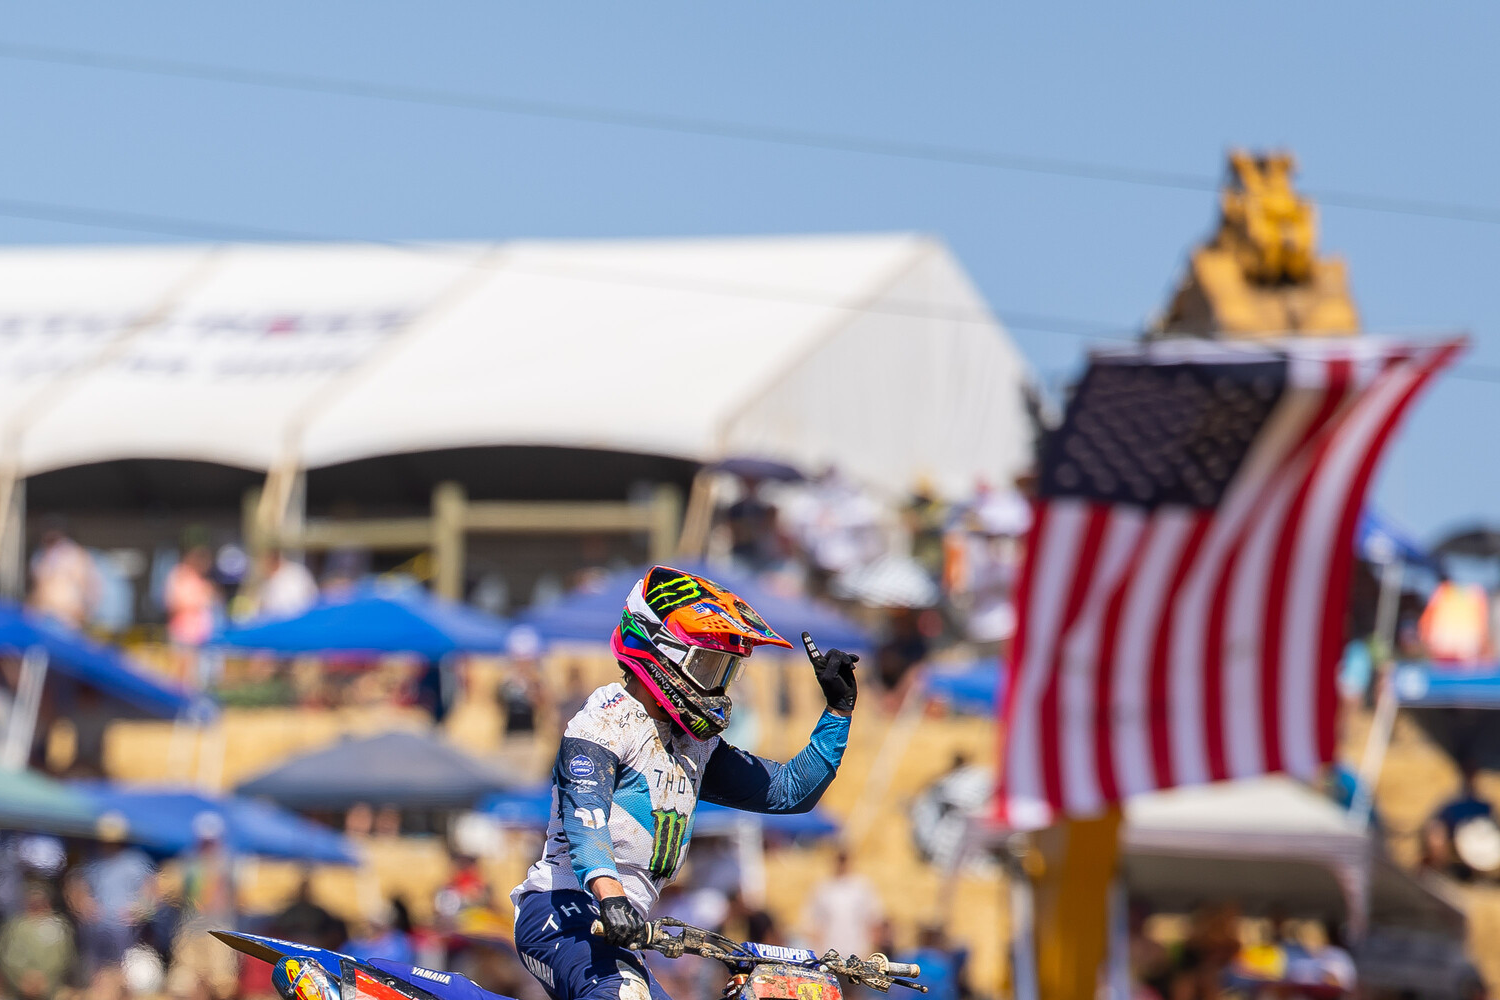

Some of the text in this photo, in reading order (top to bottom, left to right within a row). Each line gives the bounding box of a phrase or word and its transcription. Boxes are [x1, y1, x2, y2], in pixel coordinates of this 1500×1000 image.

[650, 663, 686, 708] MONSTER
[541, 901, 601, 931] THO
[411, 966, 451, 985] YAMAHA
